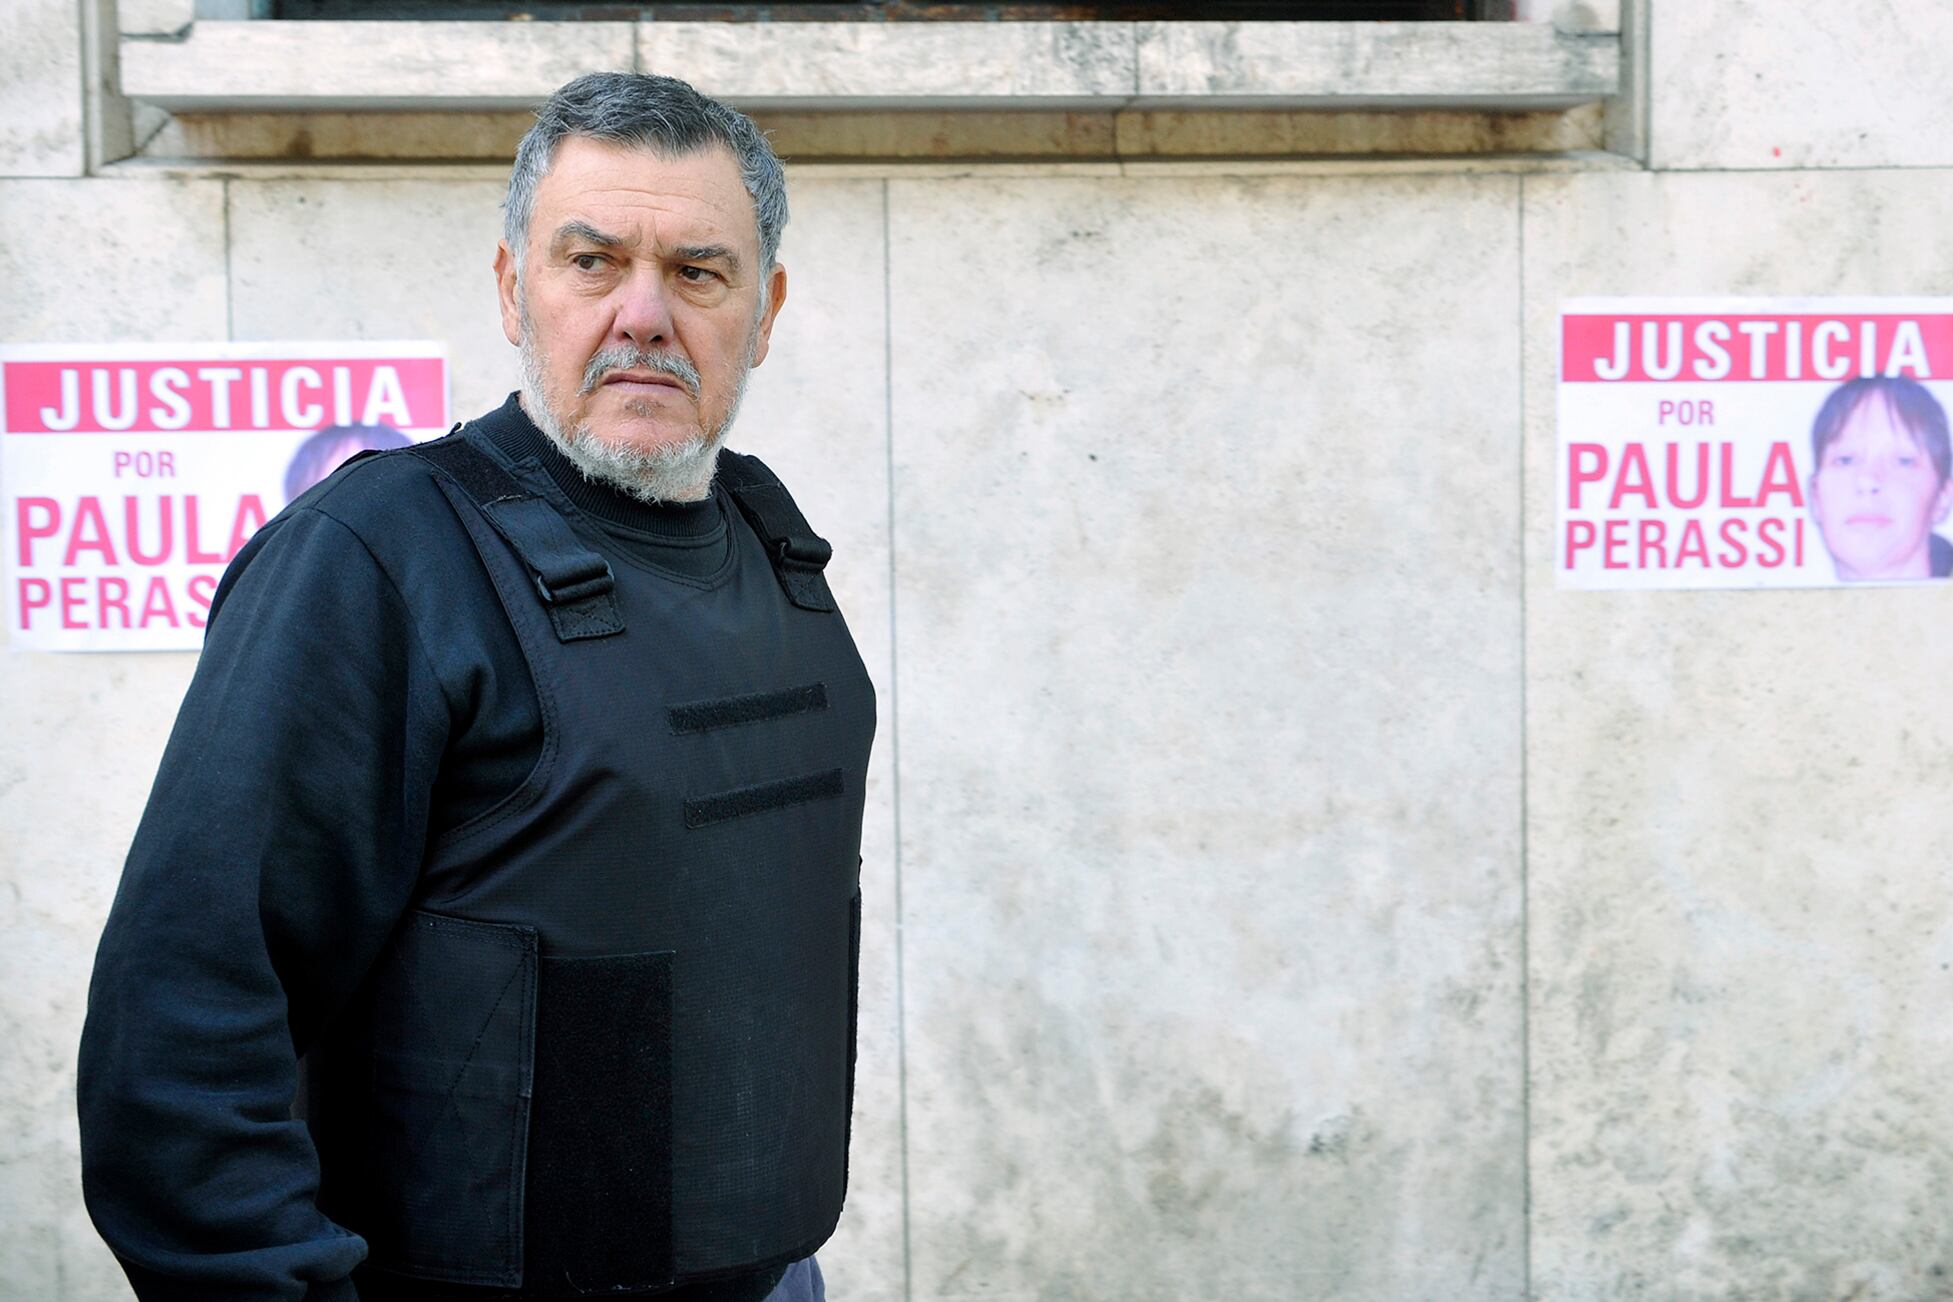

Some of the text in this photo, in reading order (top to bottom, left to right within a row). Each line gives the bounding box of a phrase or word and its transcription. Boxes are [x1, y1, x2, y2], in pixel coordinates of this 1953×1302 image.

[1593, 320, 1931, 380] JUSTICIA
[40, 366, 412, 431] JUSTICIA
[1658, 400, 1714, 425] POR
[114, 451, 175, 477] POR
[1568, 442, 1805, 509] PAULA
[17, 495, 268, 566] PAULA
[1565, 518, 1804, 569] PERASSI
[18, 575, 217, 629] PERAS
